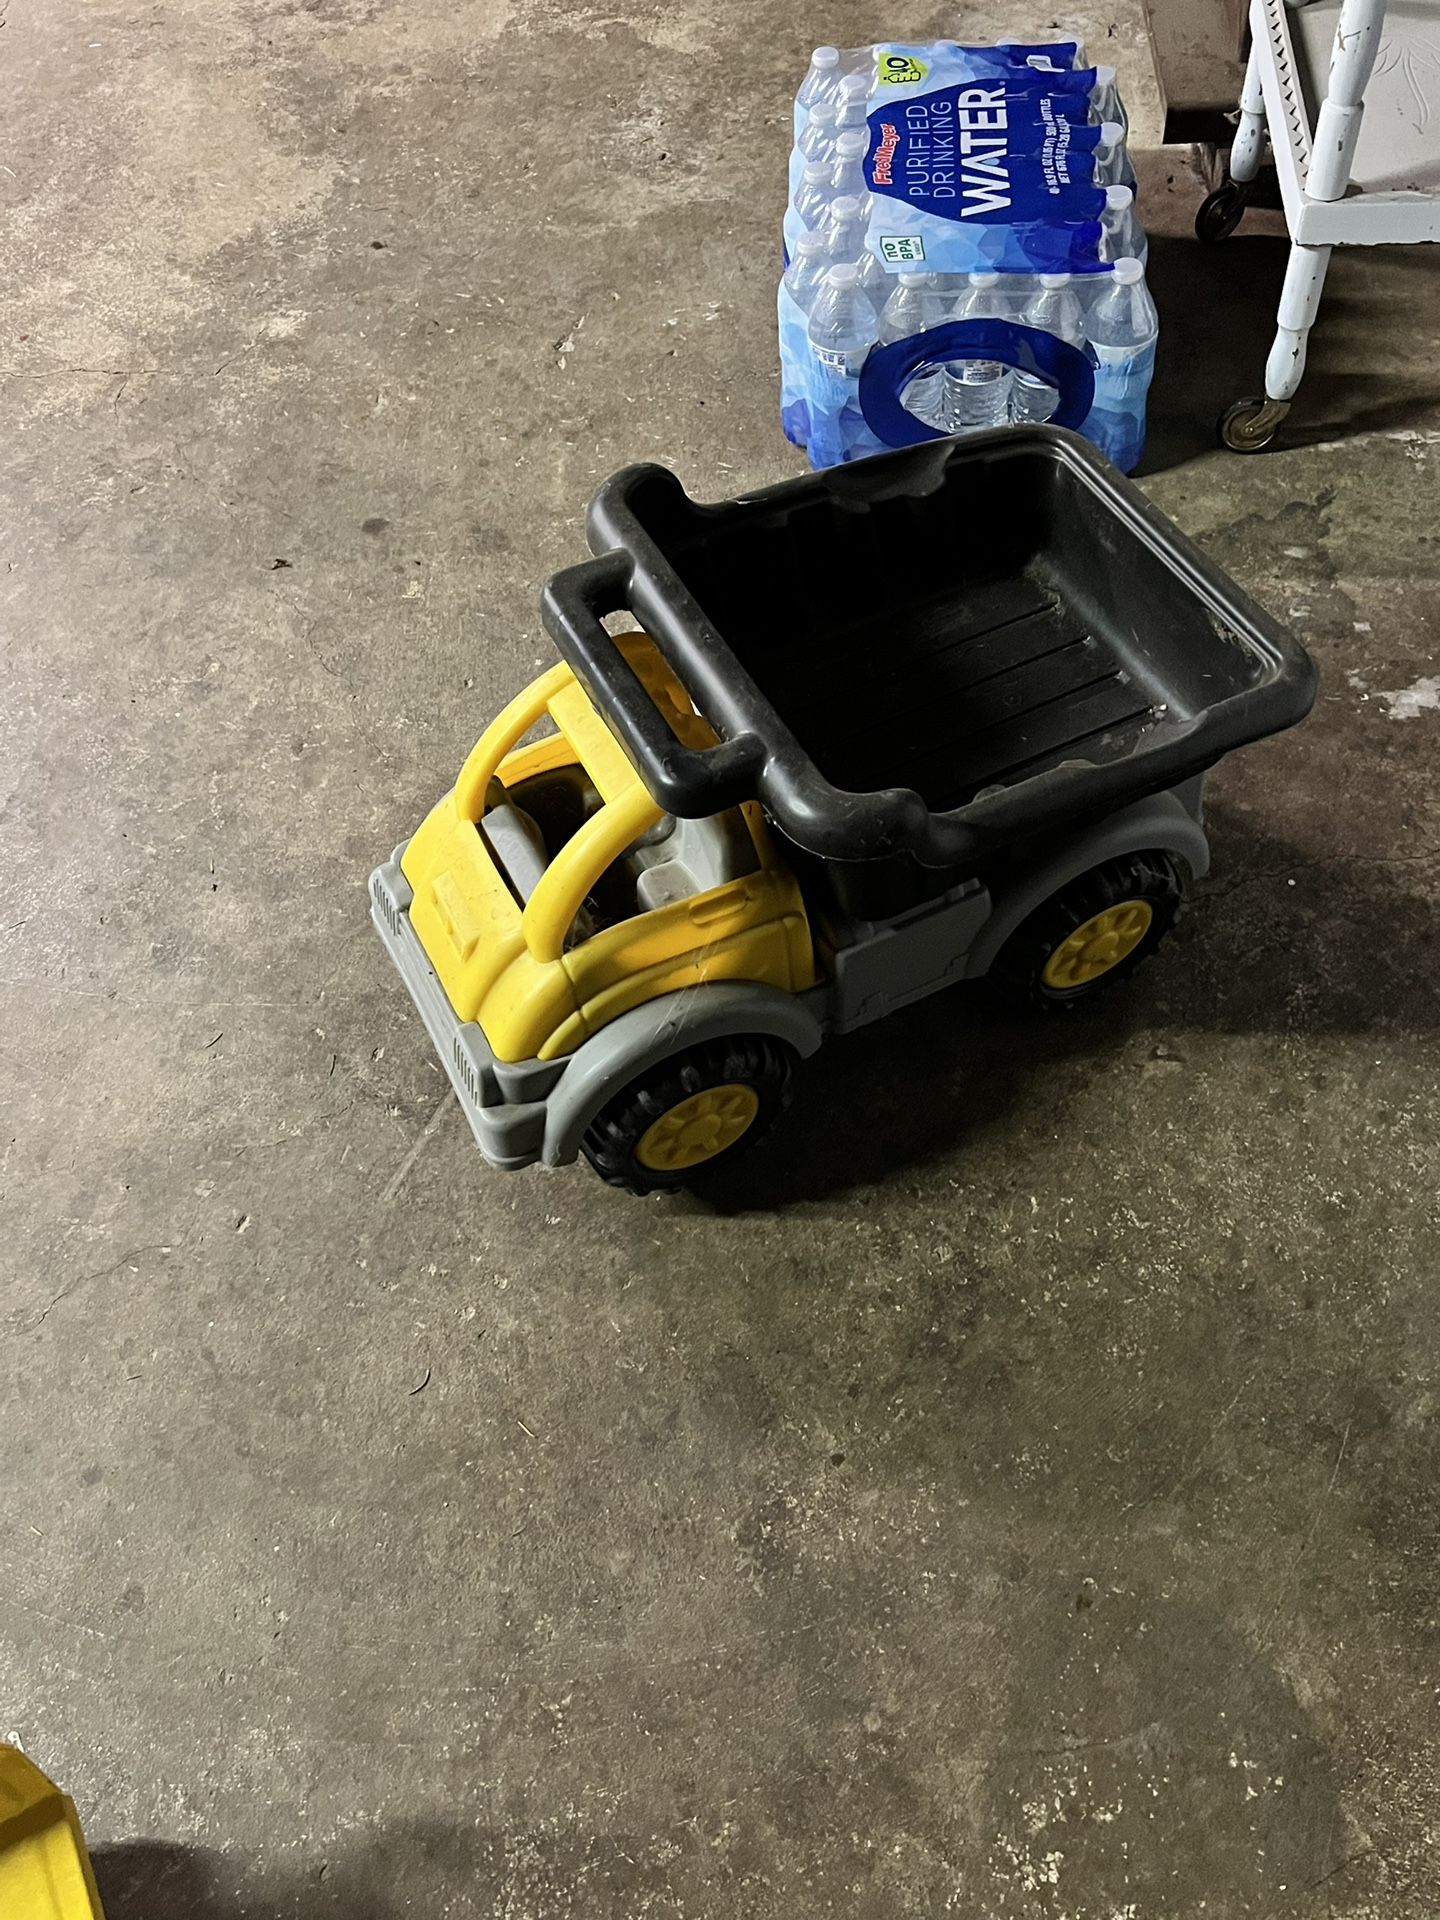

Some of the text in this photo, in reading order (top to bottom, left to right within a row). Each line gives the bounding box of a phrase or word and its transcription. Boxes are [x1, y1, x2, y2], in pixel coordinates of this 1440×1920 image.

[906, 105, 931, 196] PURIFIED
[931, 102, 956, 198] DRINKING
[957, 87, 1011, 217] WATER
[884, 243, 898, 258] no
[898, 238, 914, 260] BPA
